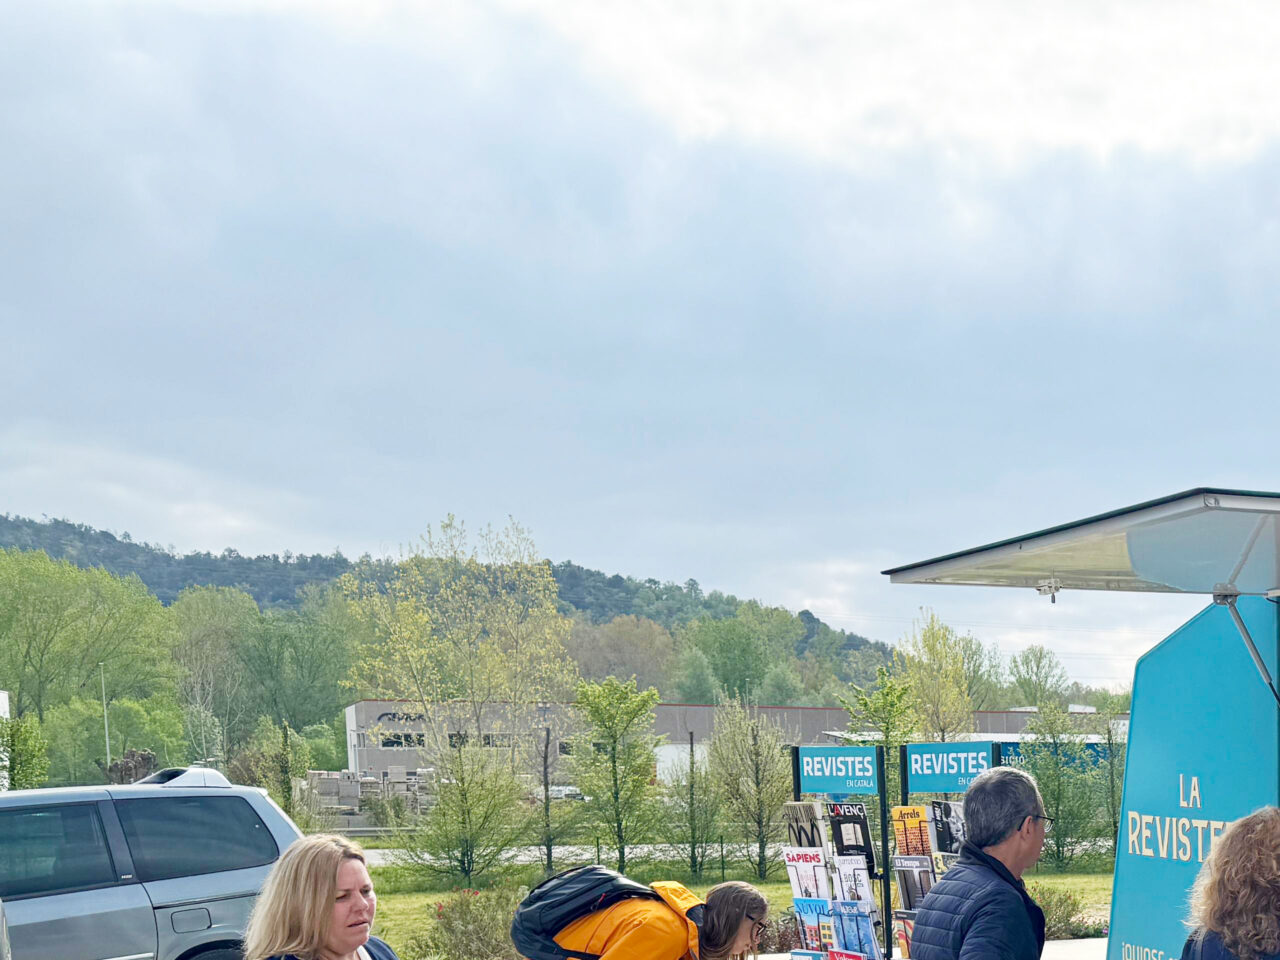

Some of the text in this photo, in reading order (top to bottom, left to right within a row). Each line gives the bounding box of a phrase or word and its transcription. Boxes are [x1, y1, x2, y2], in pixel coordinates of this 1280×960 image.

[803, 756, 873, 776] REVISTES
[911, 751, 988, 775] REVISTES
[846, 778, 874, 788] EN CATALÀ
[1179, 773, 1202, 809] LA
[827, 804, 864, 820] L'AVENÇ
[898, 808, 920, 820] Arrels
[785, 852, 821, 864] SAPIENS
